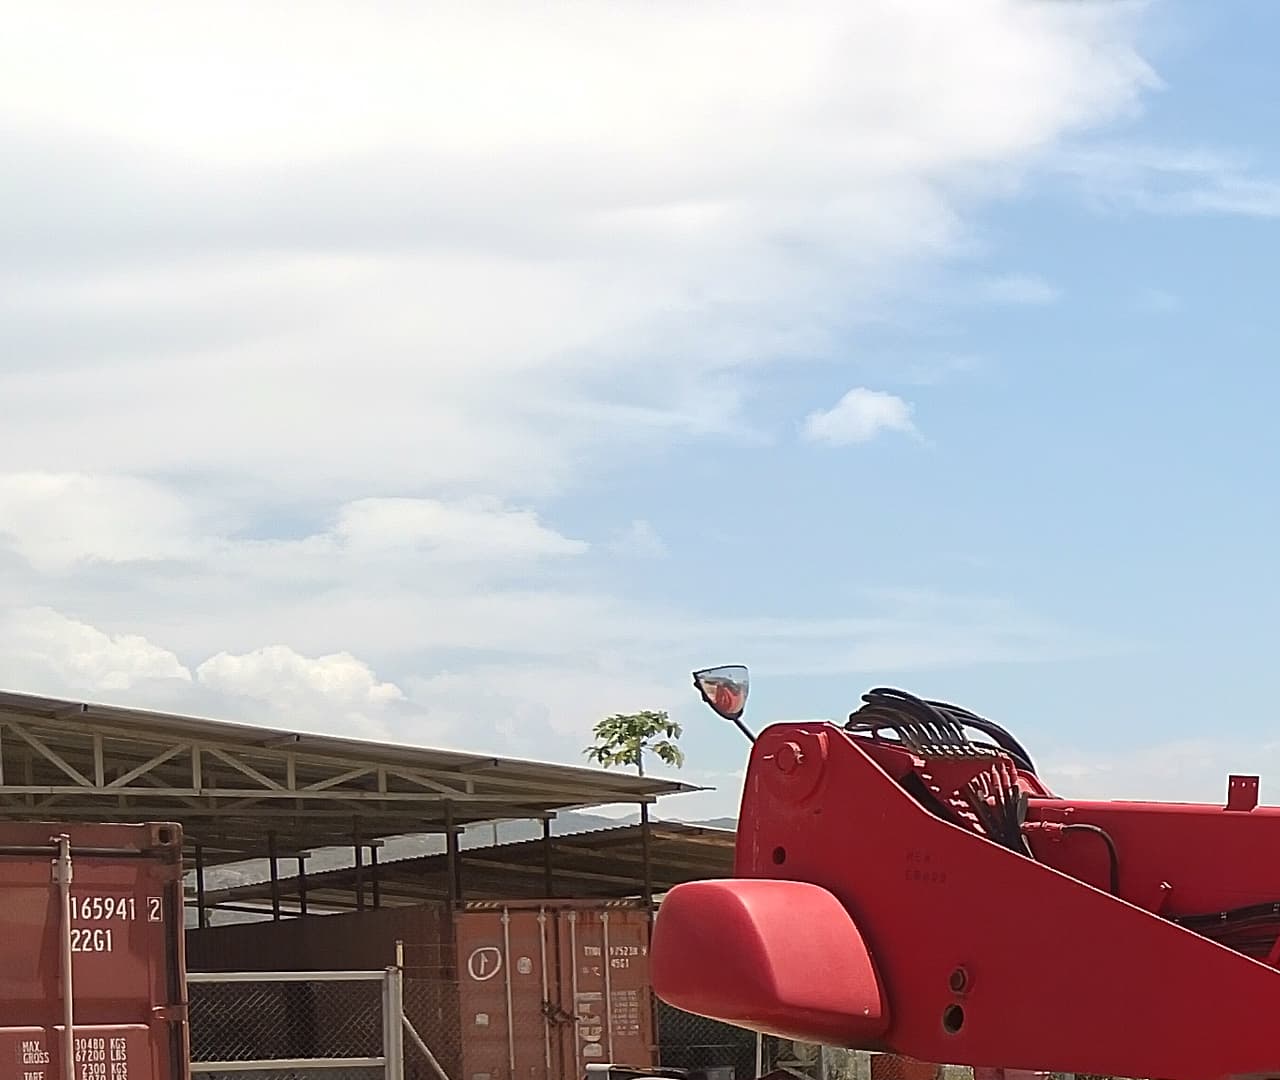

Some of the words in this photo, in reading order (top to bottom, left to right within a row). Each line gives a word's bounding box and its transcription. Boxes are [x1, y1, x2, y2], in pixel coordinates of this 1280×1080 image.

[71, 897, 135, 920] 165941
[149, 898, 161, 921] 2
[71, 929, 112, 952] 22G1
[75, 1038, 105, 1050] 30480
[110, 1038, 126, 1050] KGS
[23, 1052, 50, 1064] GROSS
[75, 1050, 105, 1062] 67200
[110, 1050, 127, 1061] LBS
[82, 1063, 106, 1074] 2300
[111, 1063, 128, 1074] KGS
